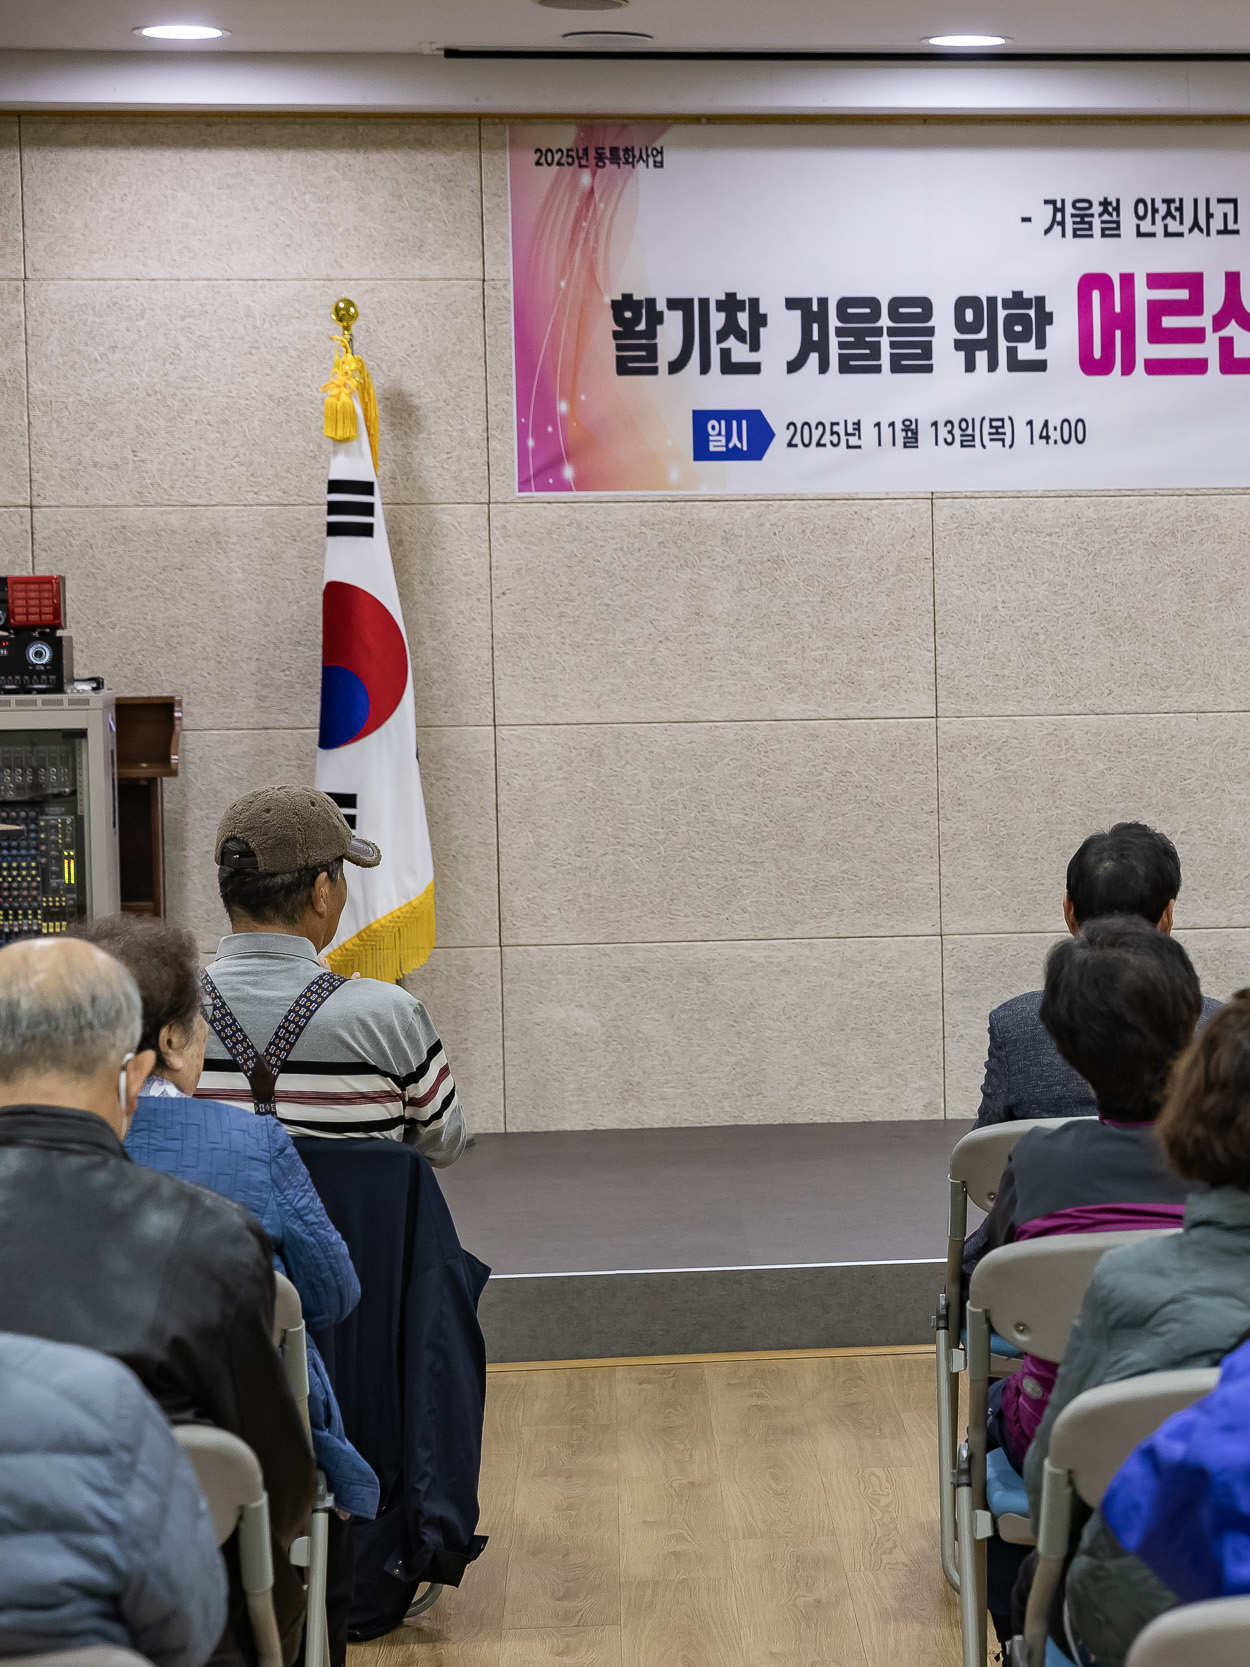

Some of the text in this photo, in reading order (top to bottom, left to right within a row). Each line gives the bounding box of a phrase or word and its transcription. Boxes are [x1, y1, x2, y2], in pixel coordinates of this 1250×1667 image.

[534, 146, 664, 169] 2025년 동특화사업
[1043, 197, 1122, 239] 겨울철
[1133, 196, 1241, 238] 안전사고
[610, 291, 768, 376] 활기찬
[784, 296, 936, 375] 겨울을
[953, 290, 1054, 373] 위한
[707, 416, 1087, 452] 일시 2025년 11월 13일(목) 14:00
